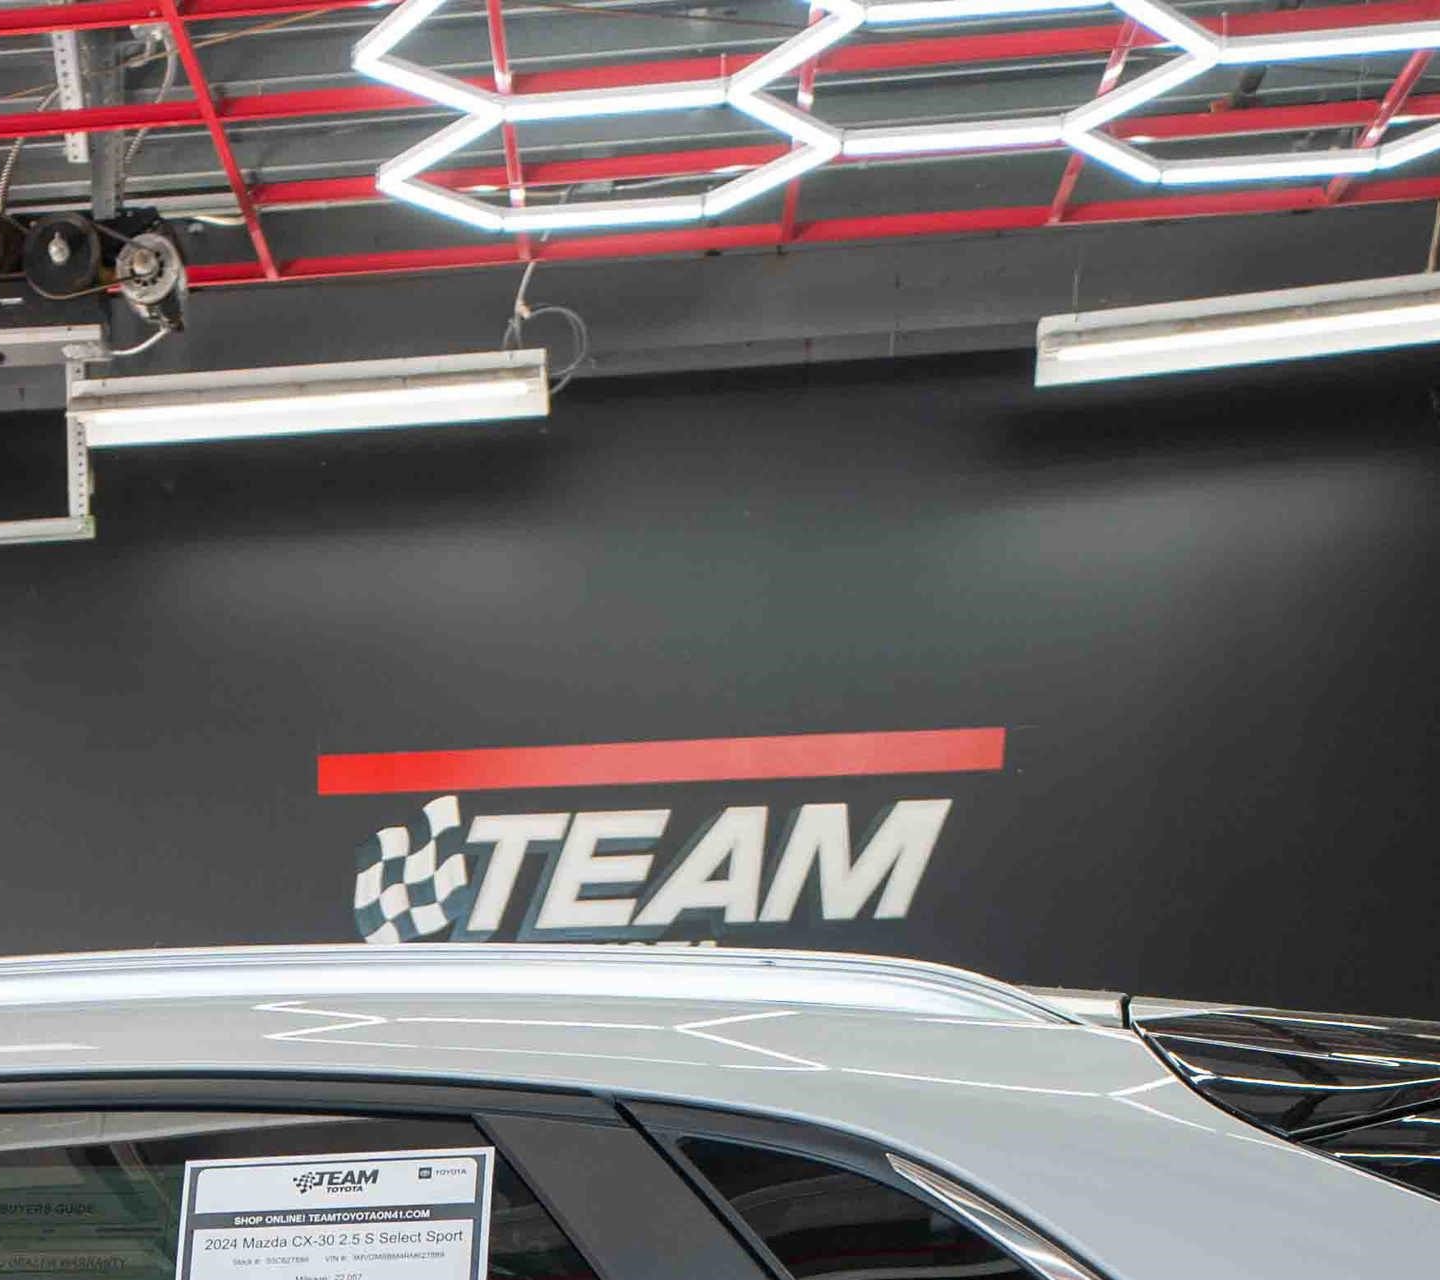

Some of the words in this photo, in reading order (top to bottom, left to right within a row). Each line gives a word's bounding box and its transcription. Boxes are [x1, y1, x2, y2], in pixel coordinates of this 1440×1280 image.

[464, 799, 953, 934] TEAM
[314, 1168, 379, 1187] TEAM
[436, 1168, 468, 1176] TOYOTA
[327, 1185, 363, 1194] TOYOTA
[233, 1215, 263, 1226] SHOP
[264, 1213, 306, 1224] ONLINE!
[308, 1209, 431, 1223] TEAMTOYOTAON41.COM
[204, 1238, 238, 1251] 2024
[242, 1236, 288, 1250] Mazda
[291, 1234, 335, 1248] CX-30
[339, 1233, 361, 1246] 2.5
[364, 1232, 375, 1245] S
[379, 1231, 422, 1244] Select
[426, 1230, 464, 1245] Sport
